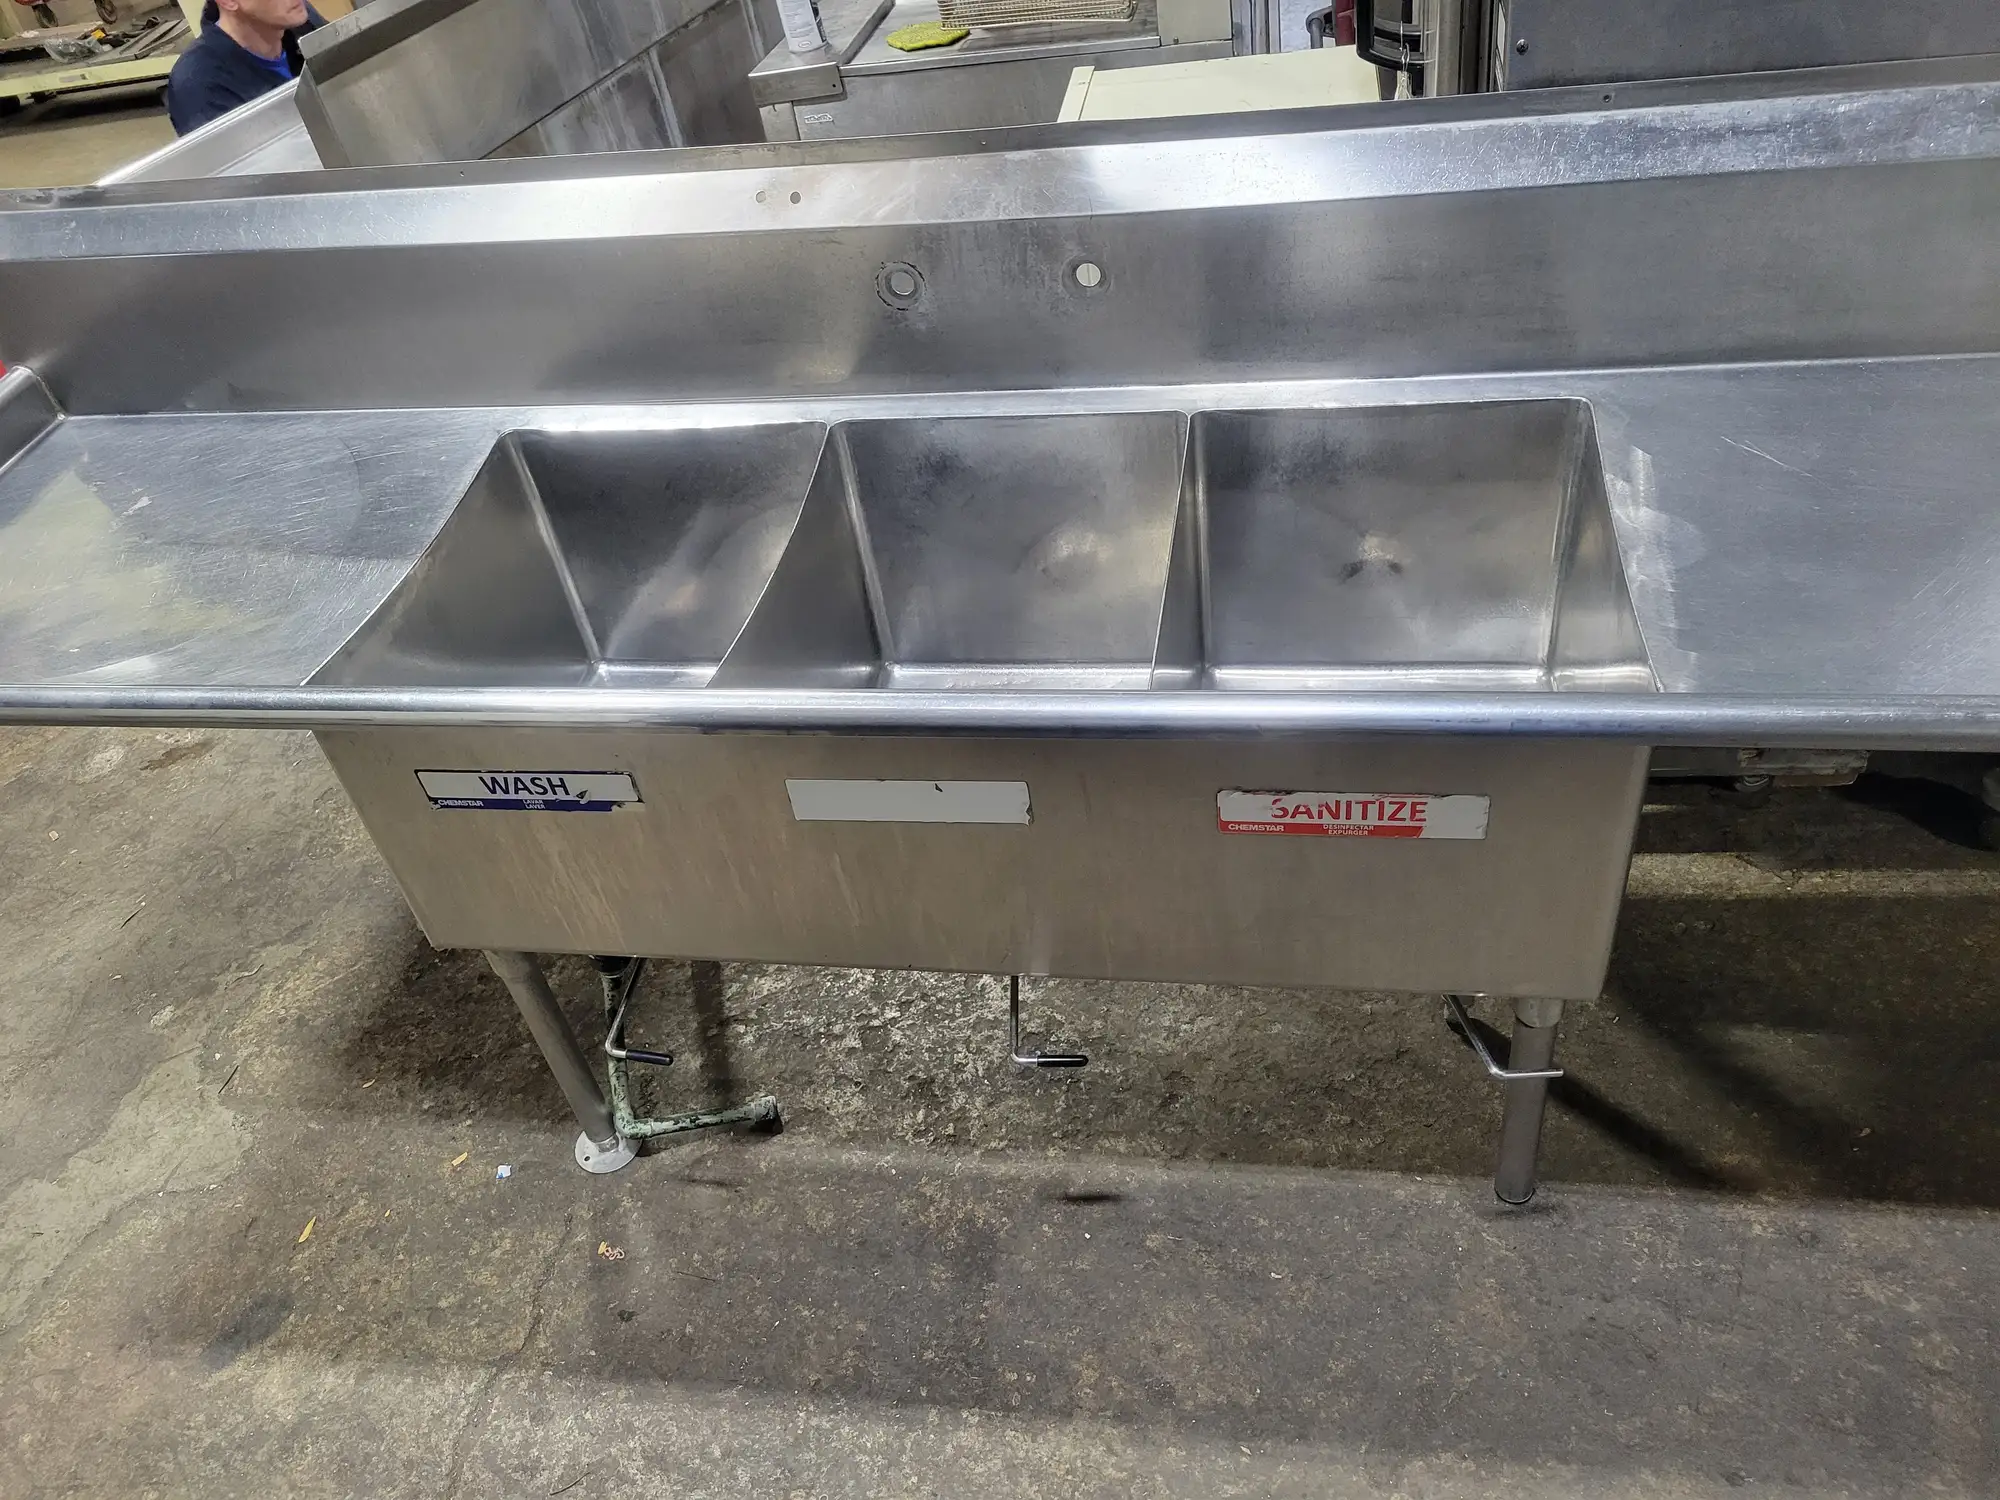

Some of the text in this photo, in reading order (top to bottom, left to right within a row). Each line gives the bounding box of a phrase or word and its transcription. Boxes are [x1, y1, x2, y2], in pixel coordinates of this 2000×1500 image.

[478, 776, 570, 796] WASH
[437, 799, 484, 807] CHEMSTAR
[1271, 797, 1428, 822] SANITIZE
[1228, 823, 1285, 832] CHEMSTAR
